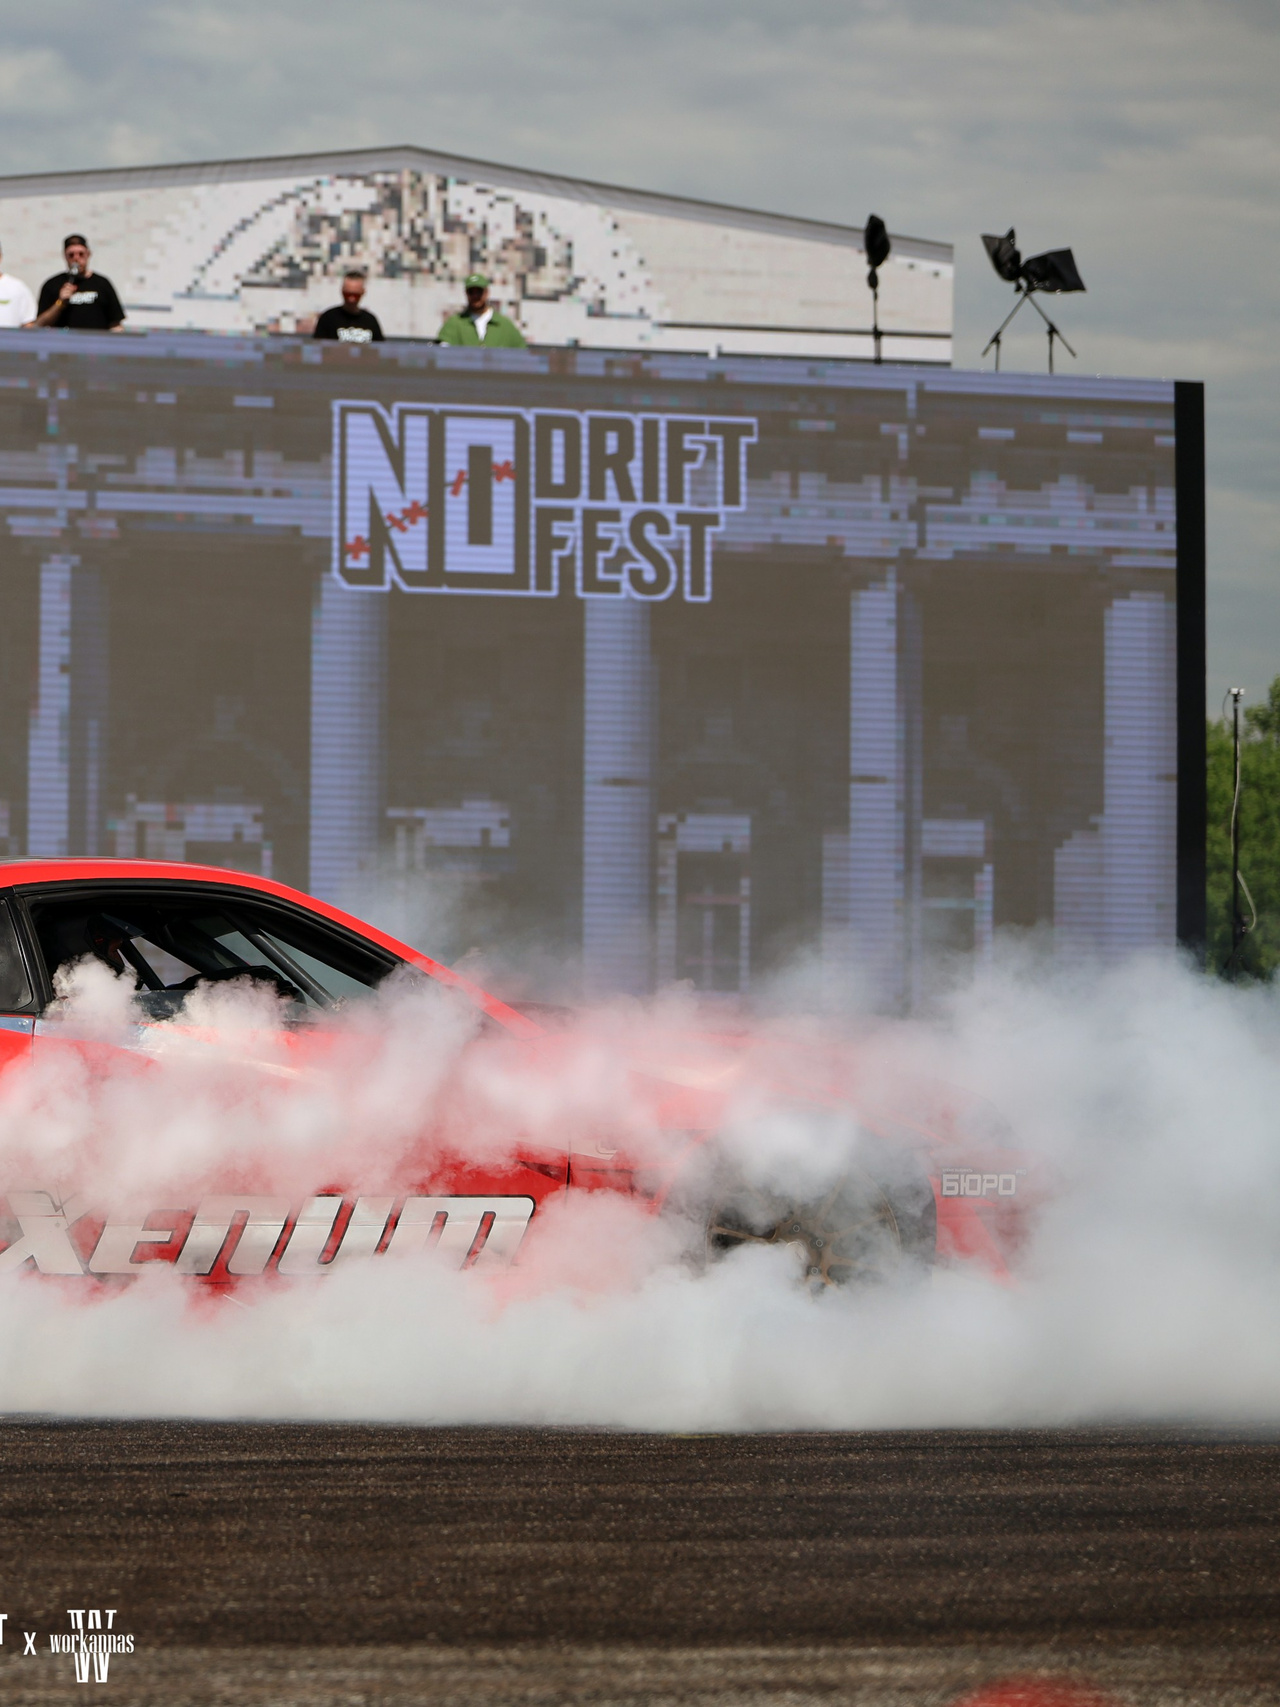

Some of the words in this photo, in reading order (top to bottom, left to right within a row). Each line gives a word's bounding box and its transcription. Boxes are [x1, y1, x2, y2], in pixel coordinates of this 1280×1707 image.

[332, 399, 531, 593] NO
[531, 408, 758, 512] DRIFT
[531, 502, 725, 602] FEST
[942, 1173, 1016, 1196] БЮРО
